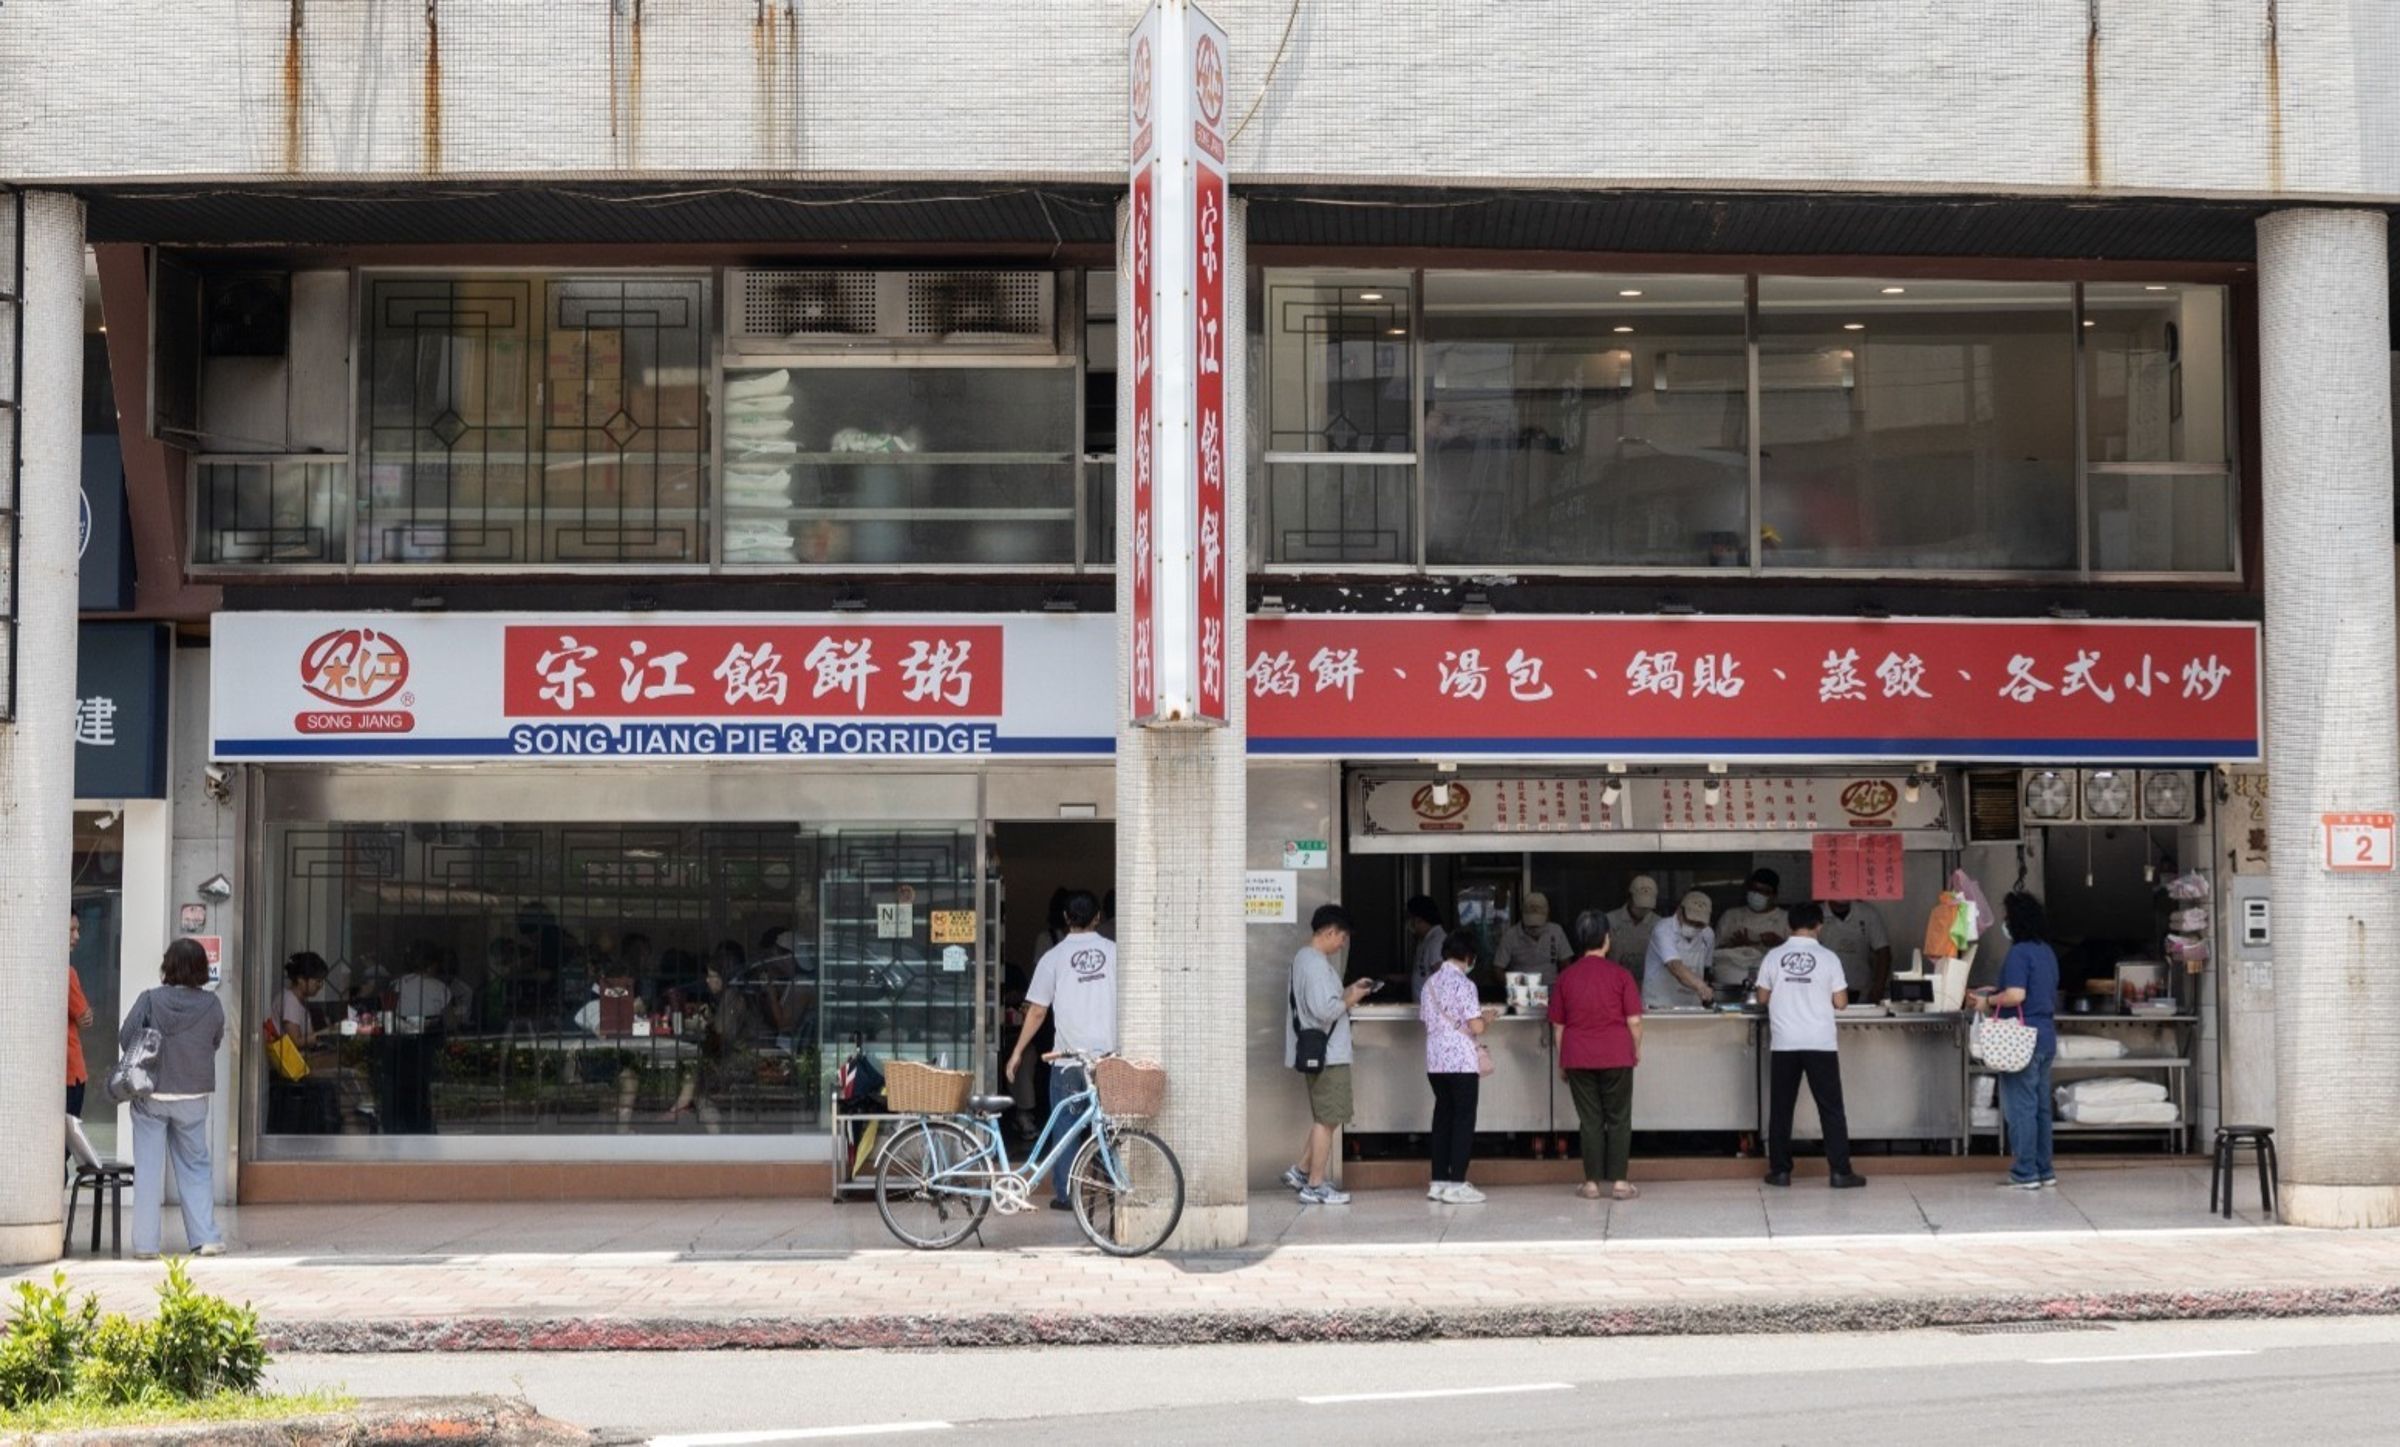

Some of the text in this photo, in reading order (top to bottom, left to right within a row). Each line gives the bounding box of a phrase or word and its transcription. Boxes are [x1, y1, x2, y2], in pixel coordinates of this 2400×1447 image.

[1201, 190, 1220, 703] 宋江餡餅粥
[536, 635, 972, 711] 宋江餡餅粥
[75, 696, 116, 746] 建
[307, 713, 402, 729] SONG JIANG
[513, 728, 993, 754] SONG JIANG PIE & PORRIDGE
[2356, 836, 2373, 862] 2
